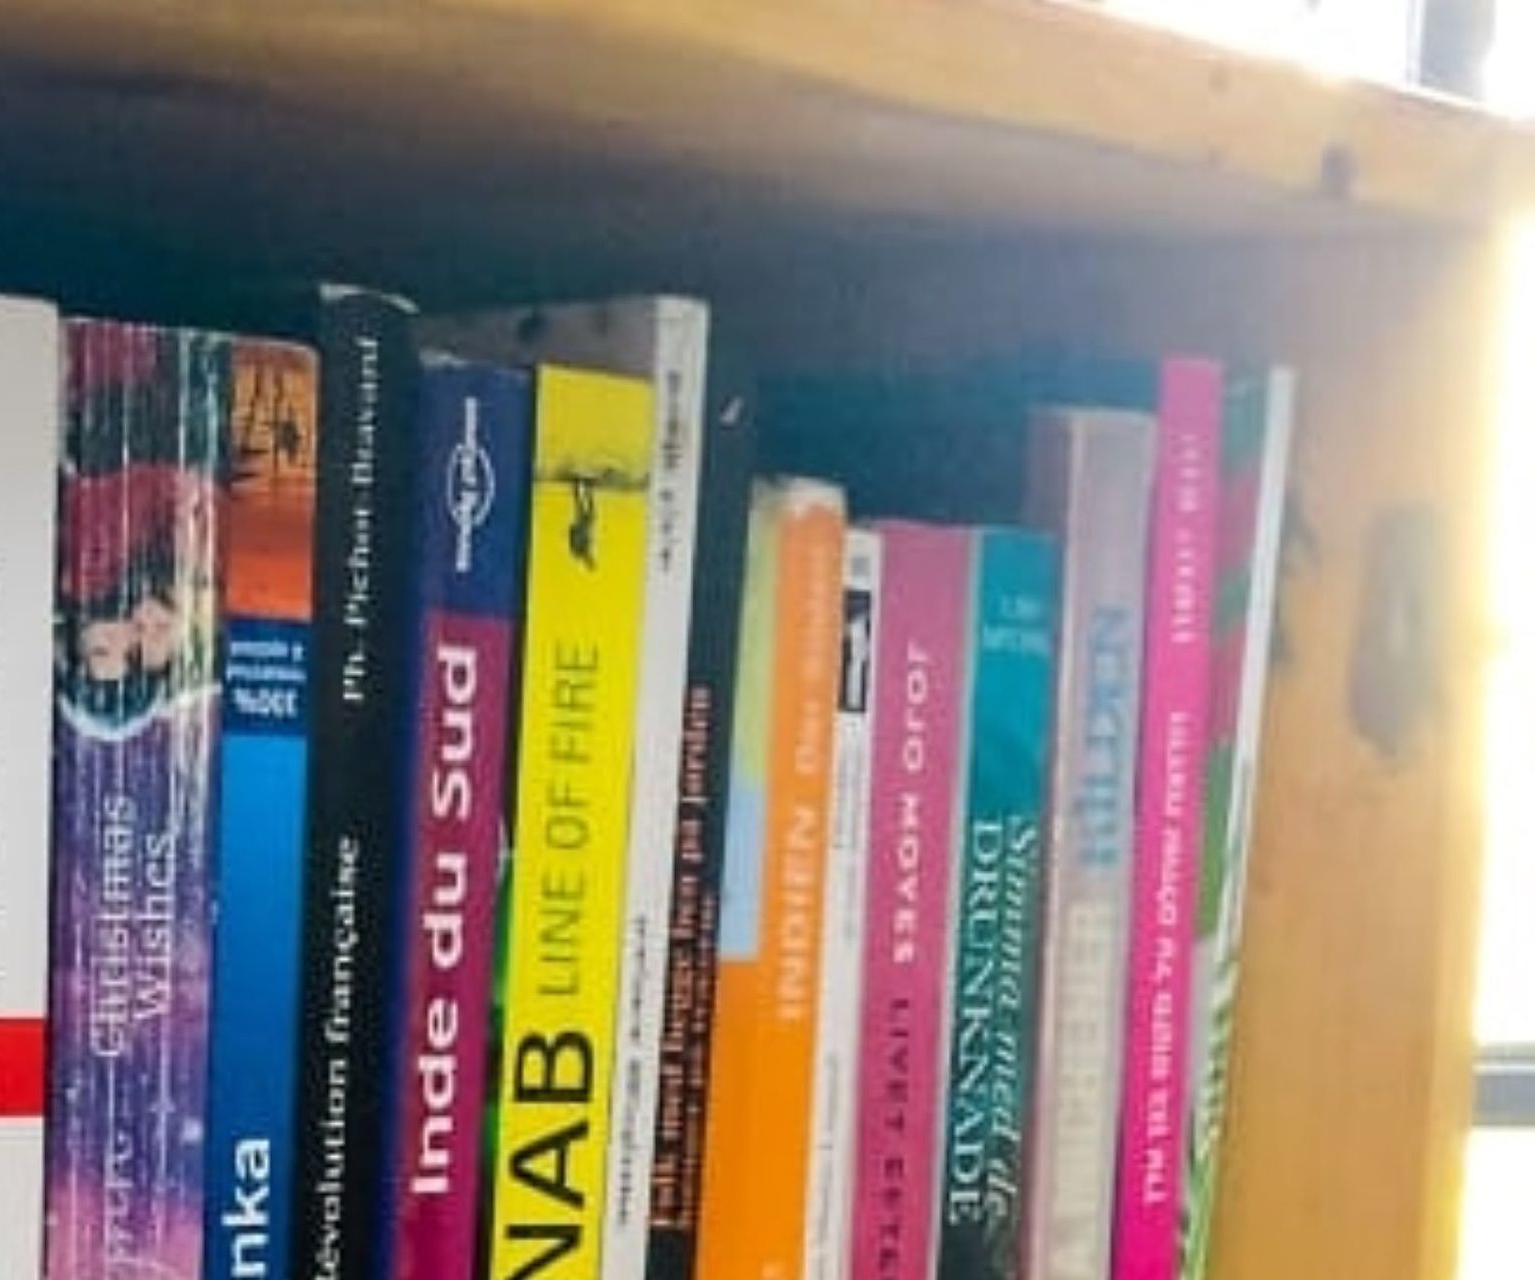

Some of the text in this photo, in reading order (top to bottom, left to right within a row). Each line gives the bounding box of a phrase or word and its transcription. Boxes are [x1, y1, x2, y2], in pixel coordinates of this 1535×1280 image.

[91, 795, 135, 1057] Christmas
[135, 832, 176, 1022] Wishes
[323, 836, 358, 1045] française
[411, 645, 479, 1194] Inde du Sud
[539, 643, 598, 995] LINE OF FIRE
[779, 808, 816, 1020] INDIEN
[892, 644, 929, 963] JOJO MOYES
[949, 820, 1003, 1225] DRUNKNADE
